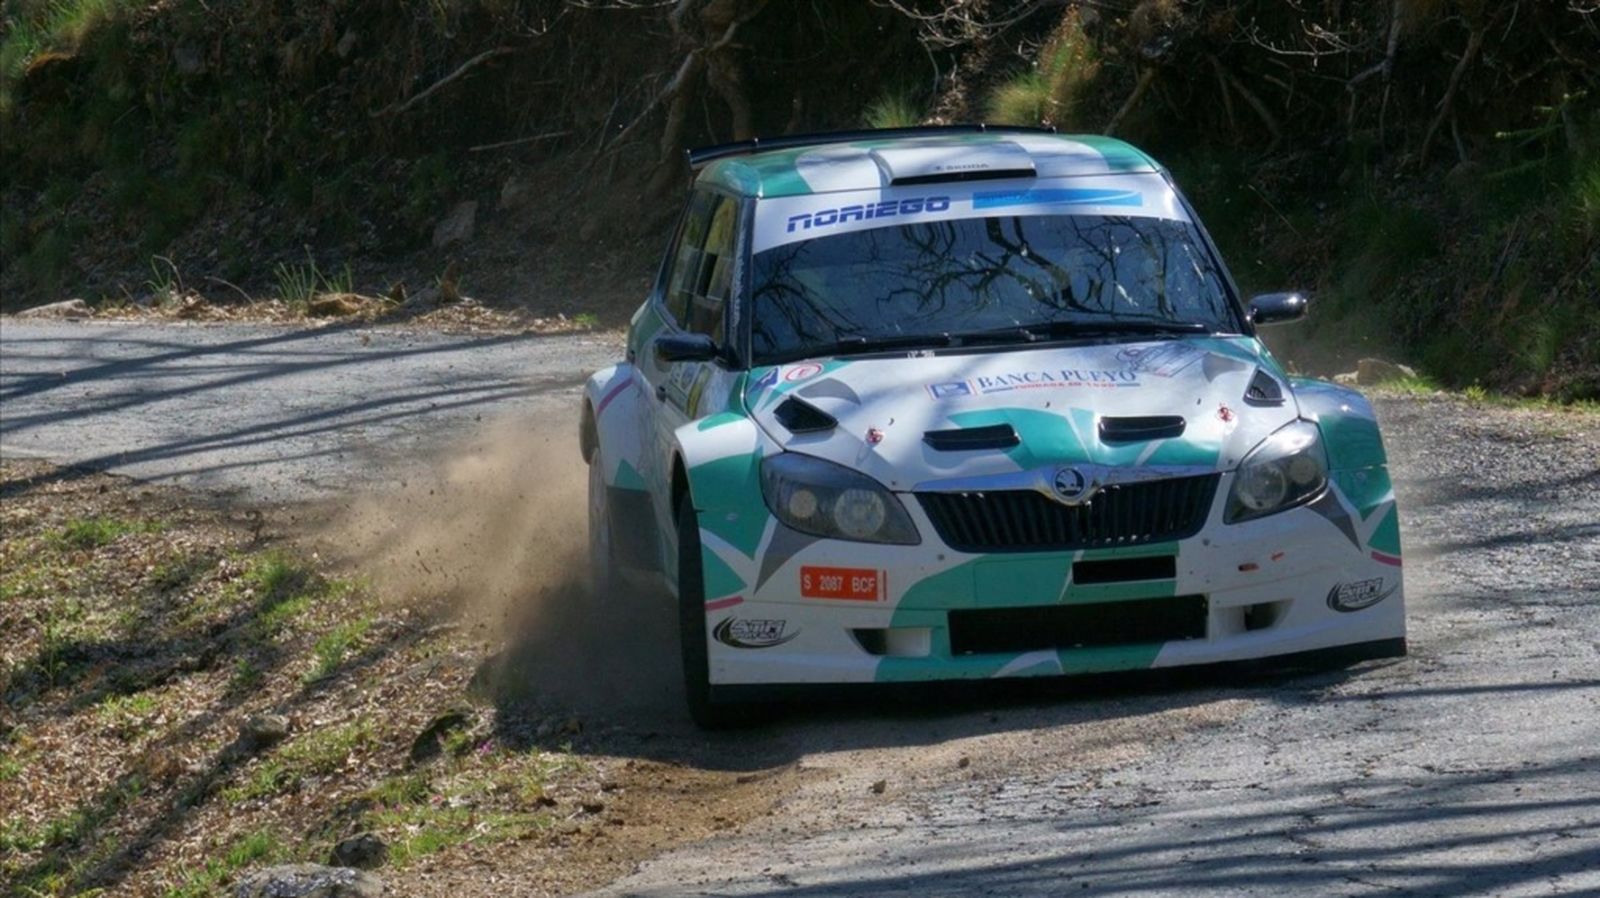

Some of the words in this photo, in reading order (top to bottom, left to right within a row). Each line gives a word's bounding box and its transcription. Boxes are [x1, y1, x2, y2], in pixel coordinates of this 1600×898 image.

[786, 196, 950, 233] NORIEGO
[977, 371, 1055, 389] BANCA
[1060, 369, 1137, 382] PUEYO
[803, 574, 812, 591] S
[852, 576, 876, 593] BCF
